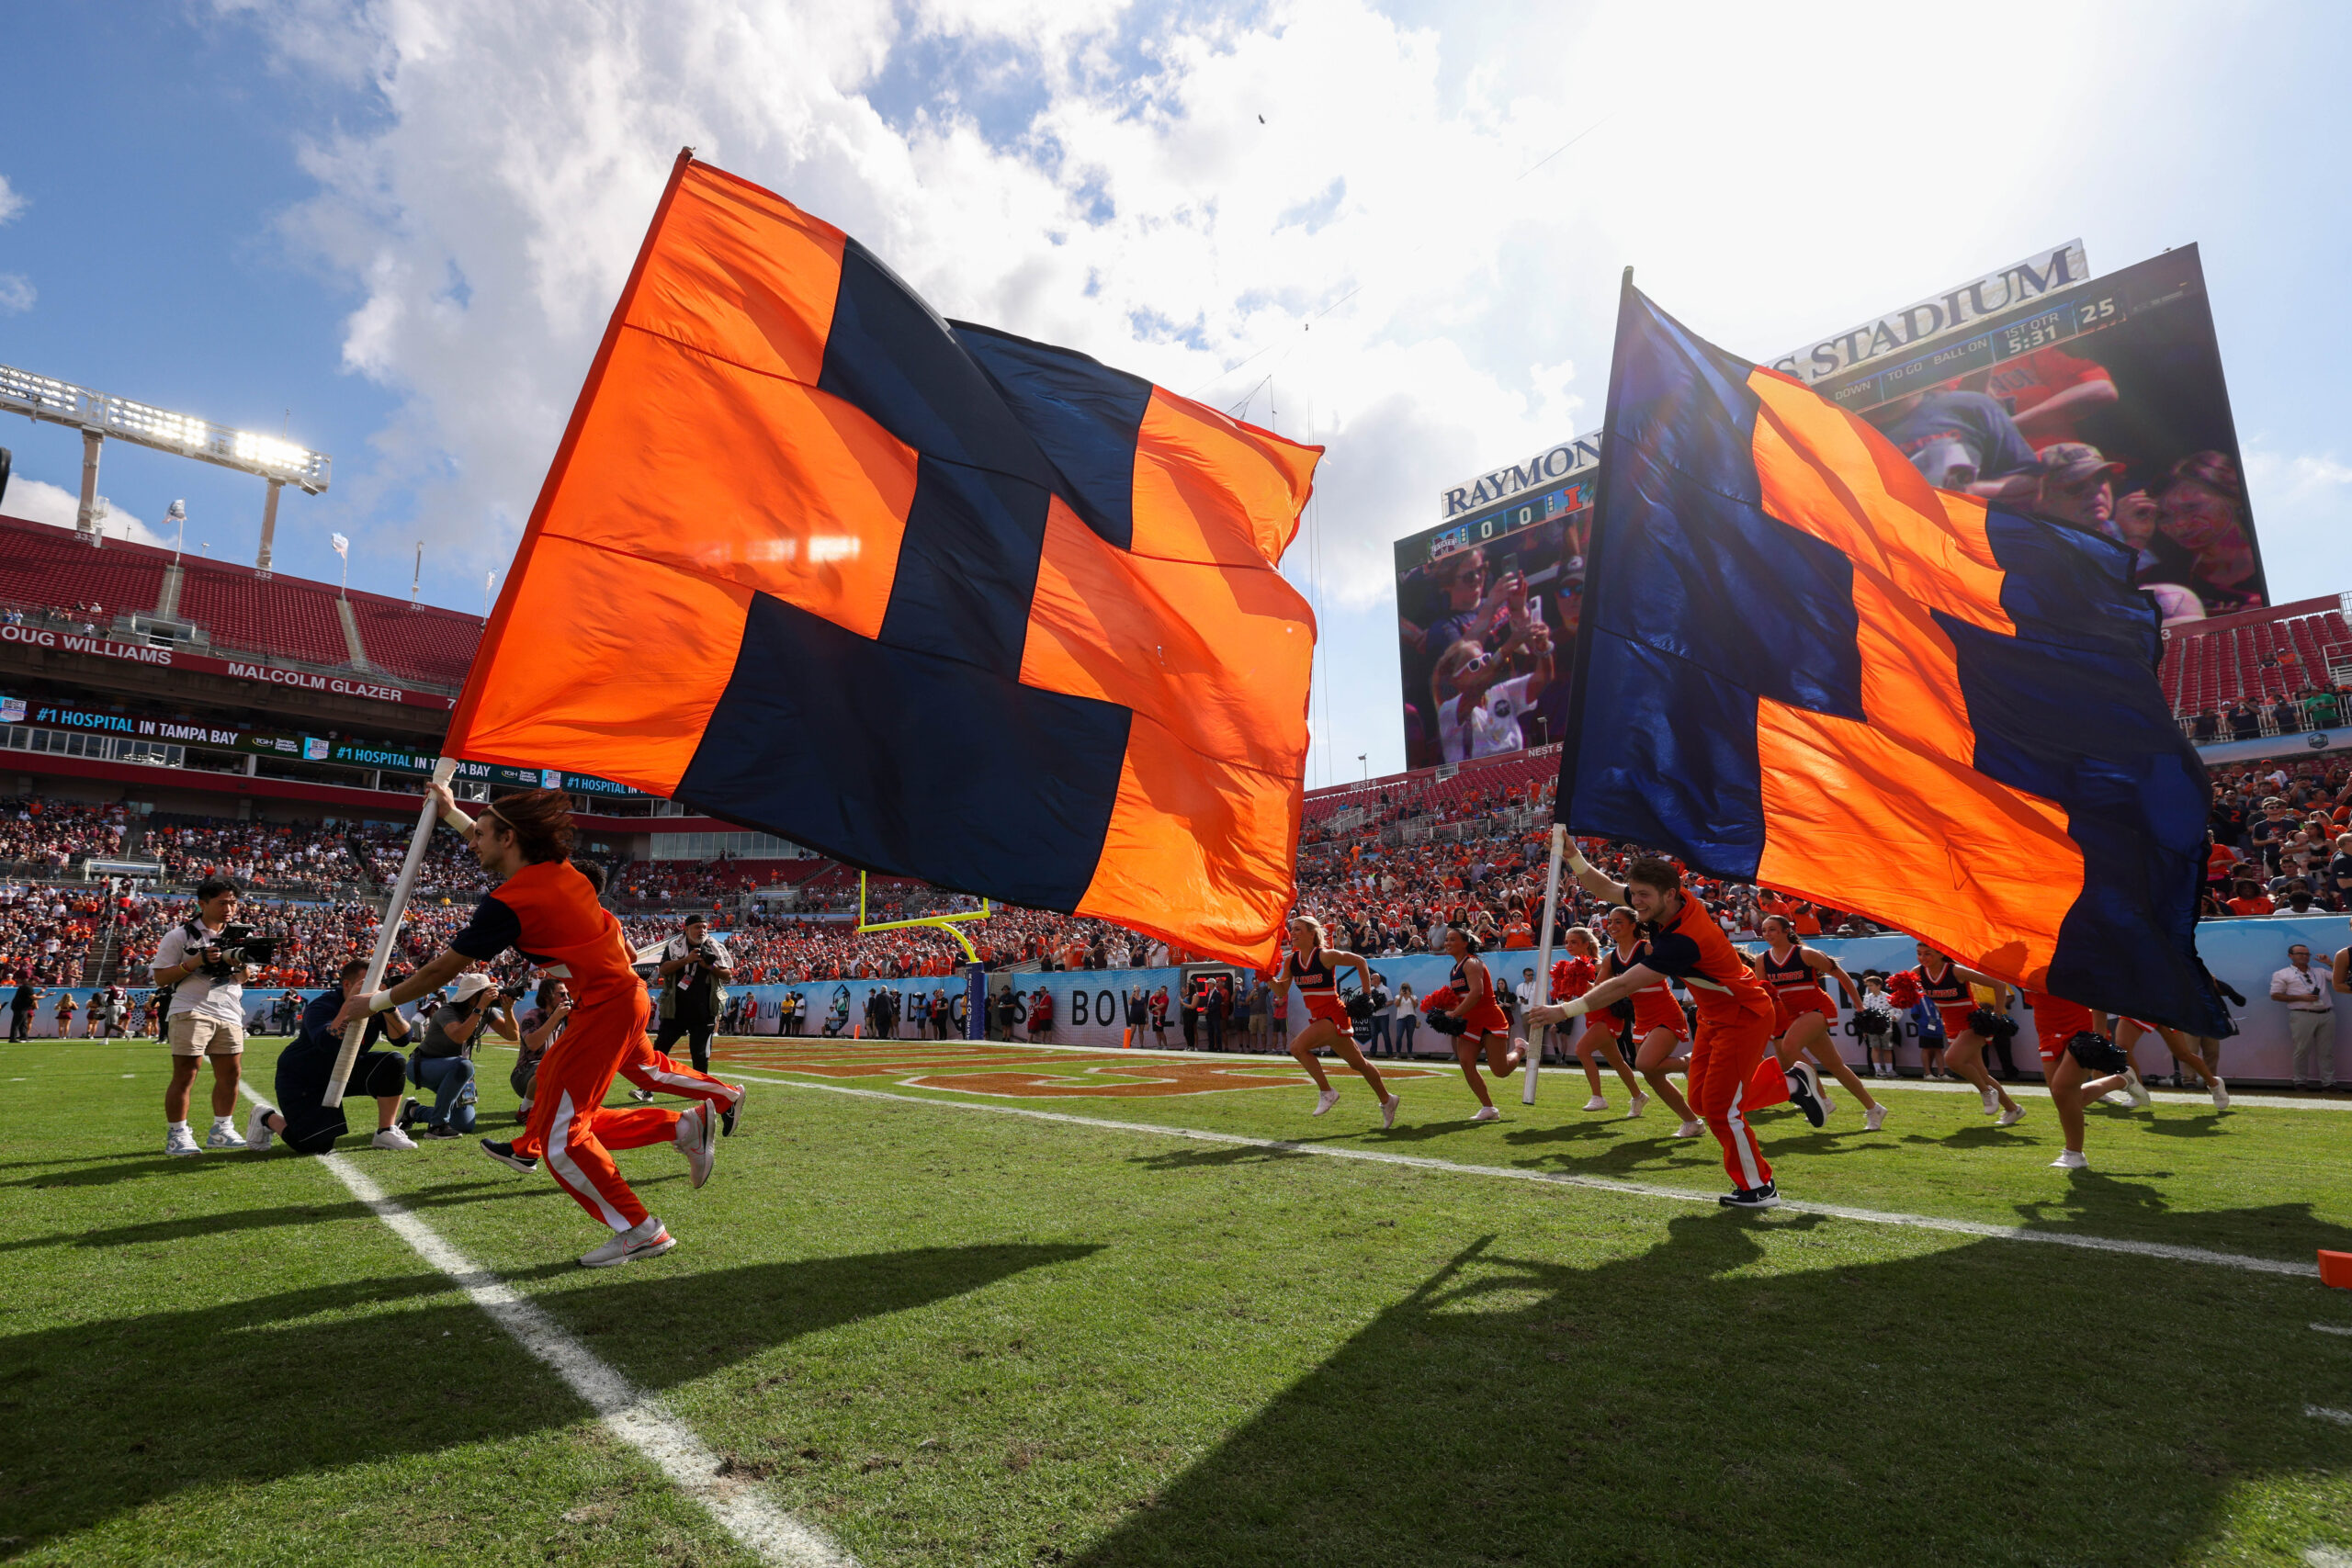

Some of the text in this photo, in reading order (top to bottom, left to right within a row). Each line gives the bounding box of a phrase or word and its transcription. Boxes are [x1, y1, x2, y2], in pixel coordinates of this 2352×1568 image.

[1811, 245, 2077, 378] STADIUM
[2080, 298, 2116, 324] 25
[2004, 312, 2060, 339] 1ST QTR
[1933, 338, 1987, 365] BALL ON
[2008, 325, 2057, 354] 5:31
[1887, 362, 1923, 381] TO GO
[1835, 381, 1871, 400] DOWN
[1519, 506, 1532, 525] 0
[1481, 521, 1493, 539] 0
[411, 603, 425, 613] 331
[0, 626, 173, 665] OUG WILLIAMS
[228, 662, 402, 703] MALCOLM GLAZER
[37, 707, 239, 745] #1 HOSPITAL IN TAMPA BAY
[336, 747, 492, 777] #1 HOSPITAL IN TPA BAY
[1528, 746, 1555, 758] NEST
[567, 777, 580, 788] #1
[582, 778, 627, 795] HOSPITAL
[117, 990, 124, 999] 7
